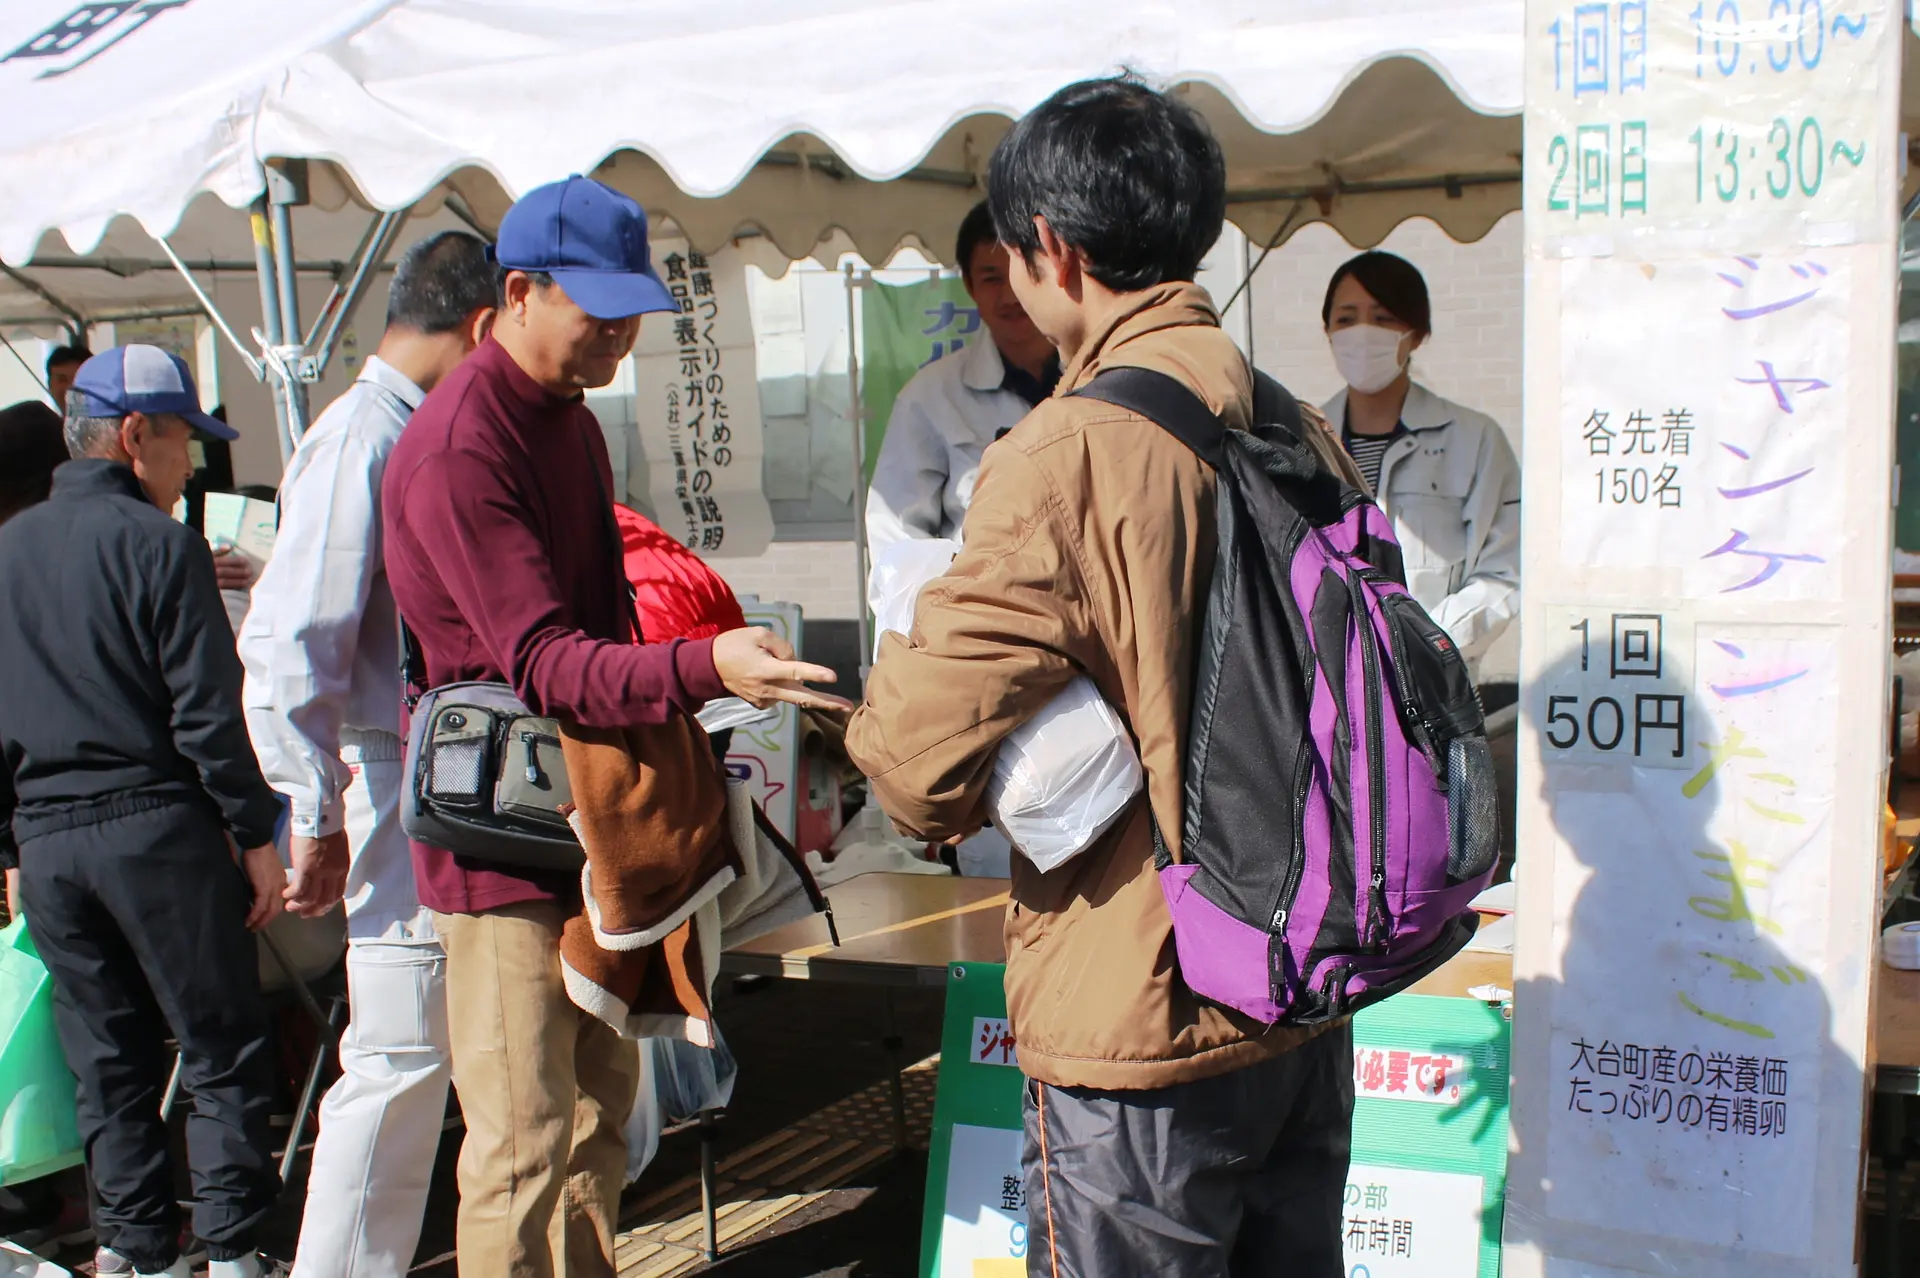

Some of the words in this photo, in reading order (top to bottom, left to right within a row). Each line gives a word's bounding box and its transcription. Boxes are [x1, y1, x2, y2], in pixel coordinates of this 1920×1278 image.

[1547, 2, 1647, 98] 1回目
[1547, 121, 1647, 219] 2回目
[1582, 409, 1695, 457] 各先着
[1594, 462, 1682, 508] 150名
[1570, 614, 1663, 679] 1回
[1546, 693, 1685, 758] 50円
[980, 1022, 1018, 1064] ジャ
[1567, 1038, 1788, 1097] 大台町産の栄養価
[1568, 1077, 1787, 1139] たっぷりの有精卵
[1000, 1175, 1026, 1211] 整
[1342, 1214, 1412, 1258] 布時間
